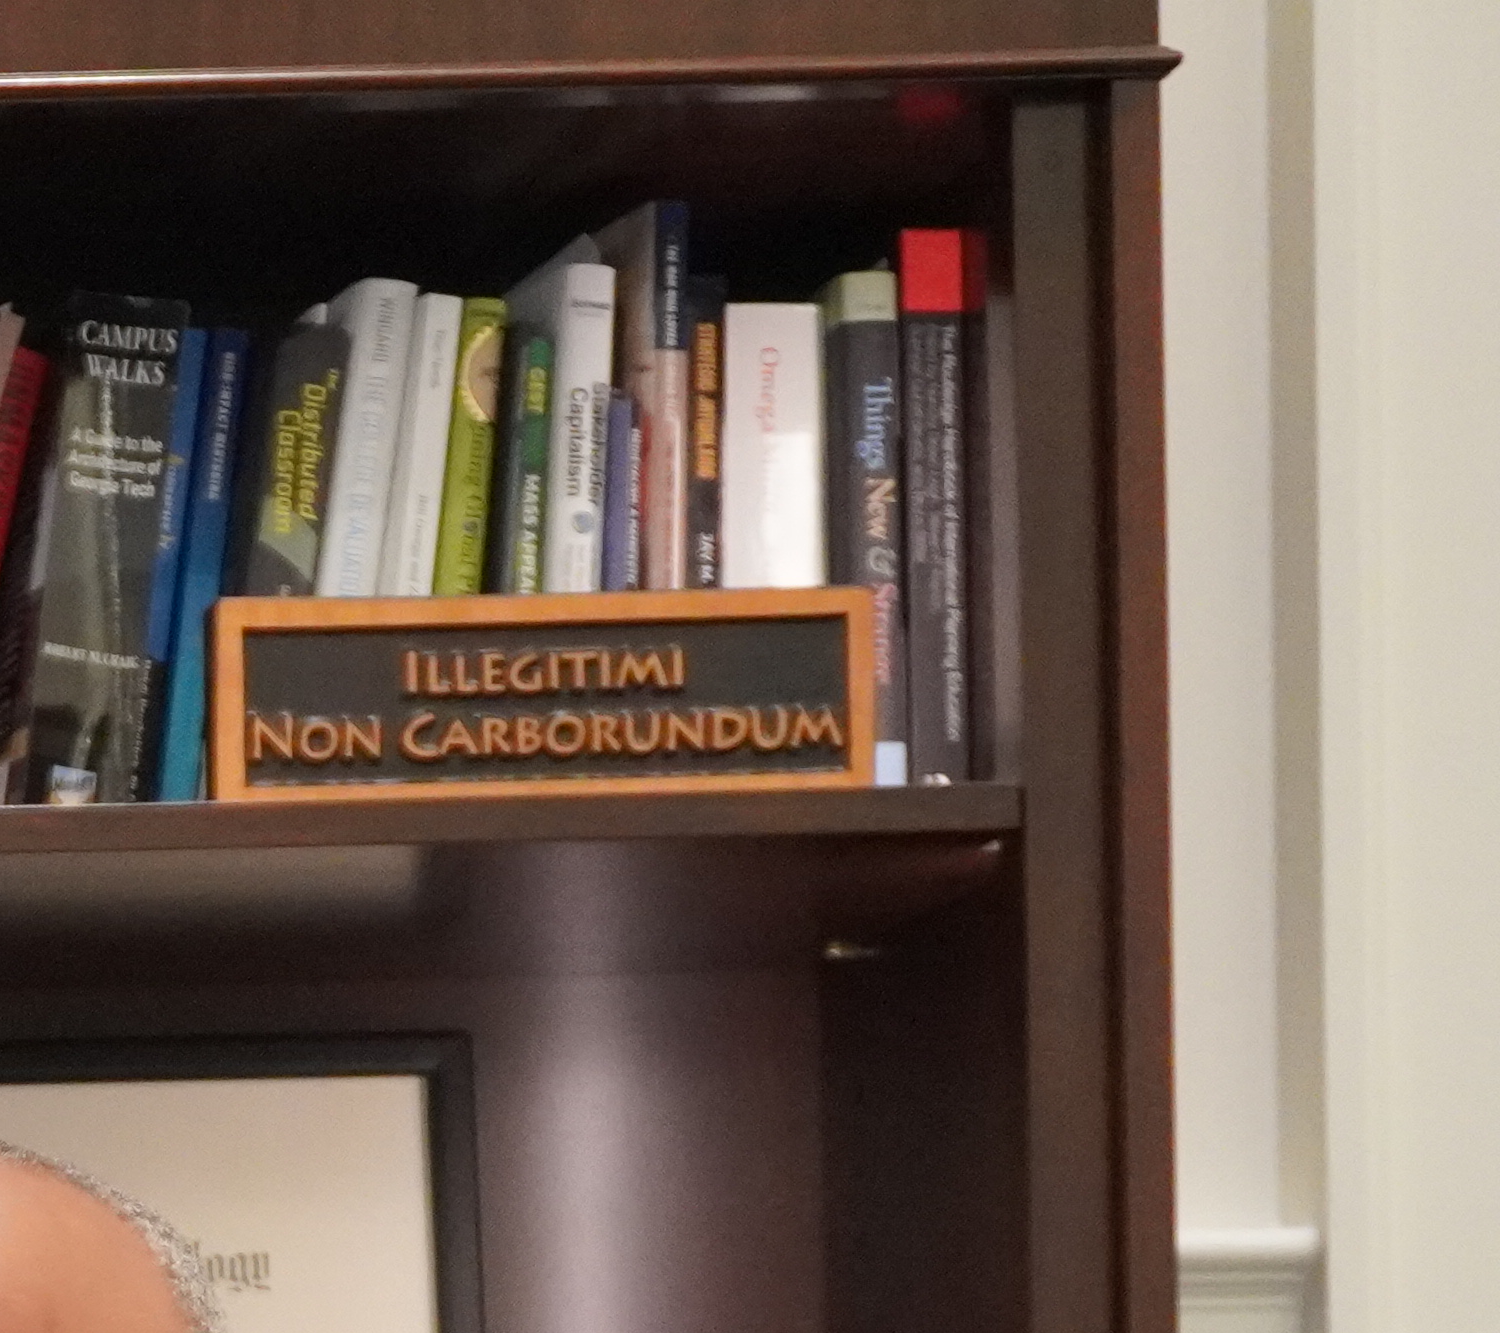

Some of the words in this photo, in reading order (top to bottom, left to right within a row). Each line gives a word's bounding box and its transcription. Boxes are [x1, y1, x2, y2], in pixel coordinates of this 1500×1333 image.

[78, 319, 180, 353] CAMPUS
[85, 353, 166, 385] WALKS
[756, 346, 781, 433] Omega
[300, 383, 328, 521] Distributed
[566, 386, 589, 497] Capitalism
[589, 382, 611, 505] Stakeholder
[856, 377, 894, 471] Things
[122, 479, 156, 498] Tech
[273, 410, 301, 534] Classroom
[865, 476, 897, 540] New
[699, 531, 717, 560] JAY
[868, 546, 897, 577] &
[404, 643, 687, 696] ILLEGITIMI
[248, 711, 383, 763] NON
[401, 704, 845, 760] CARBORUNDUM
